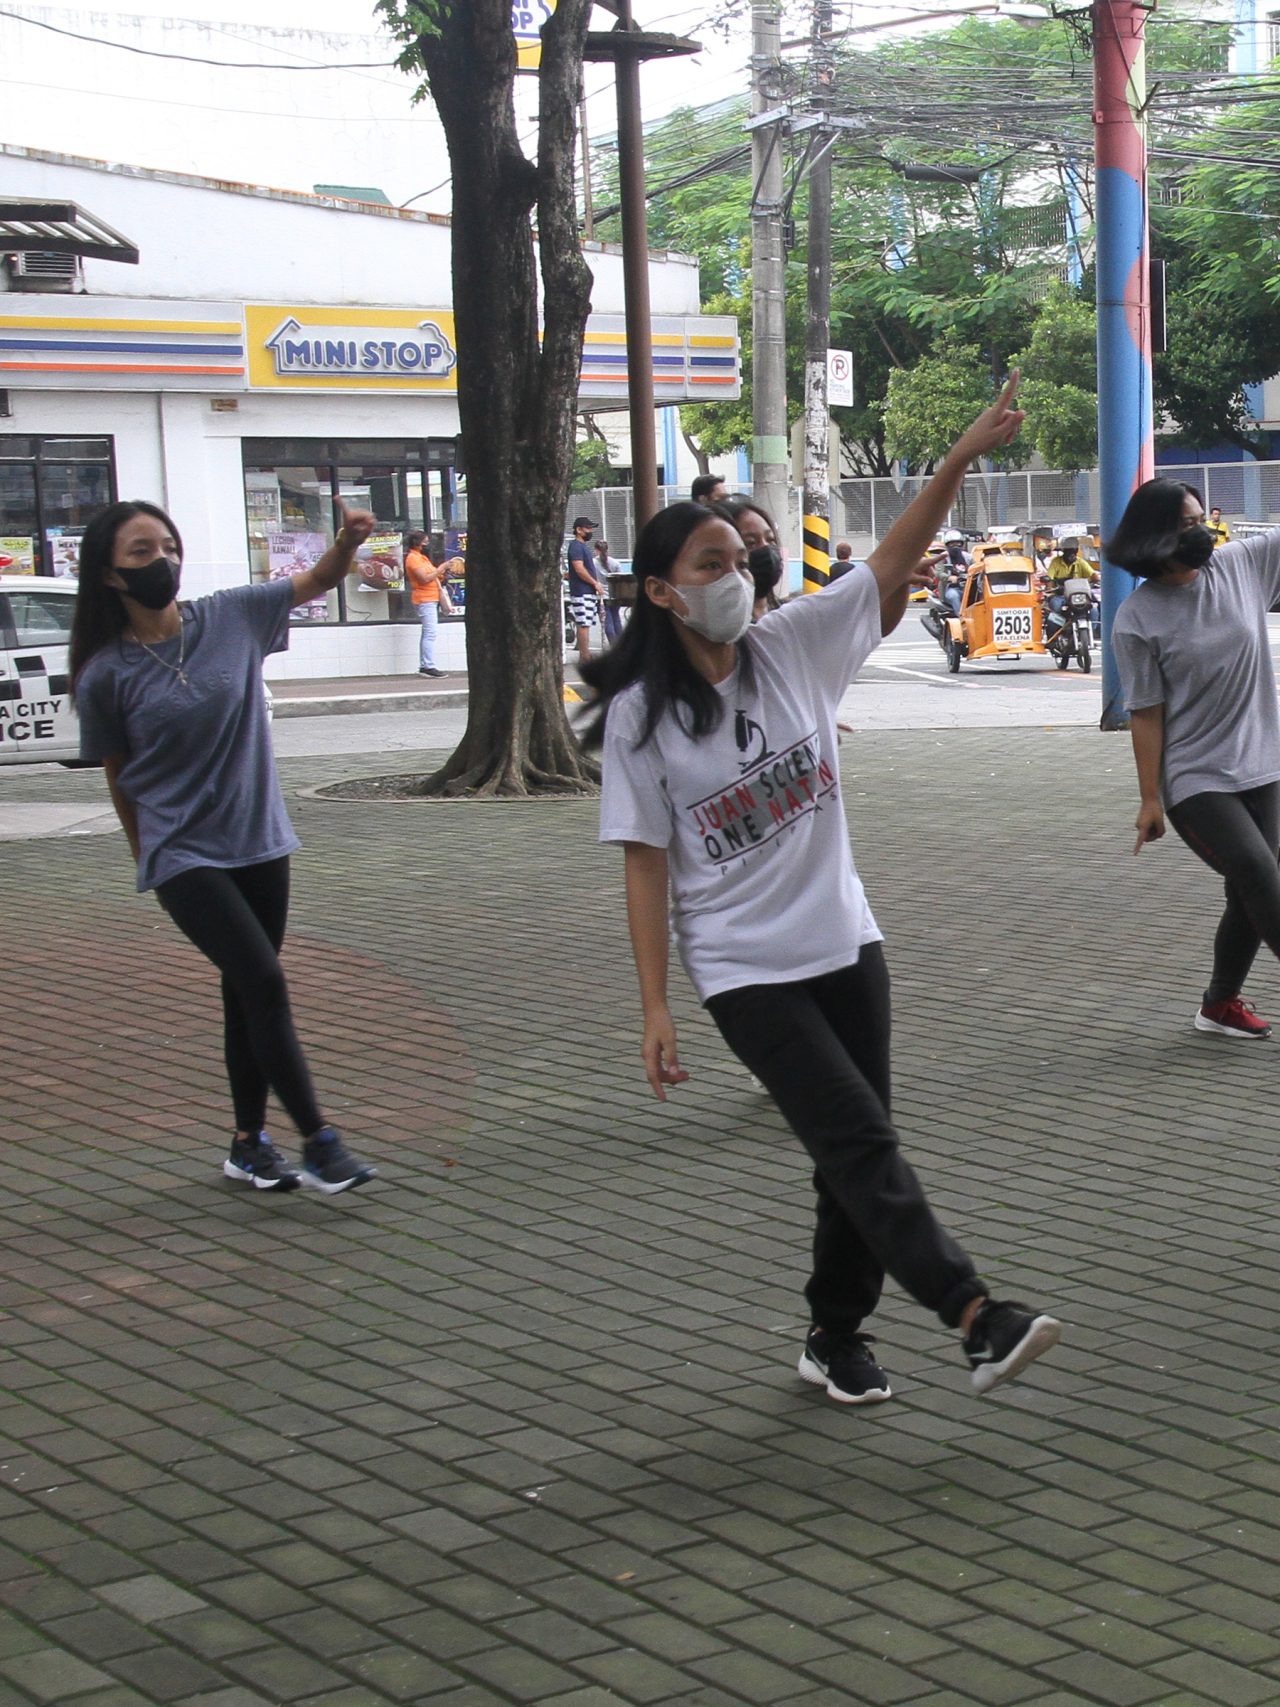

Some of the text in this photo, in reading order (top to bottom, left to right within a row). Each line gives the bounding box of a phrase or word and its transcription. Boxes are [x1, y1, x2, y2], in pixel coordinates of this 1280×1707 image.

[994, 615, 1031, 636] 2503
[16, 699, 62, 718] CITY
[693, 783, 757, 836] JUAN
[704, 814, 762, 860] ONE
